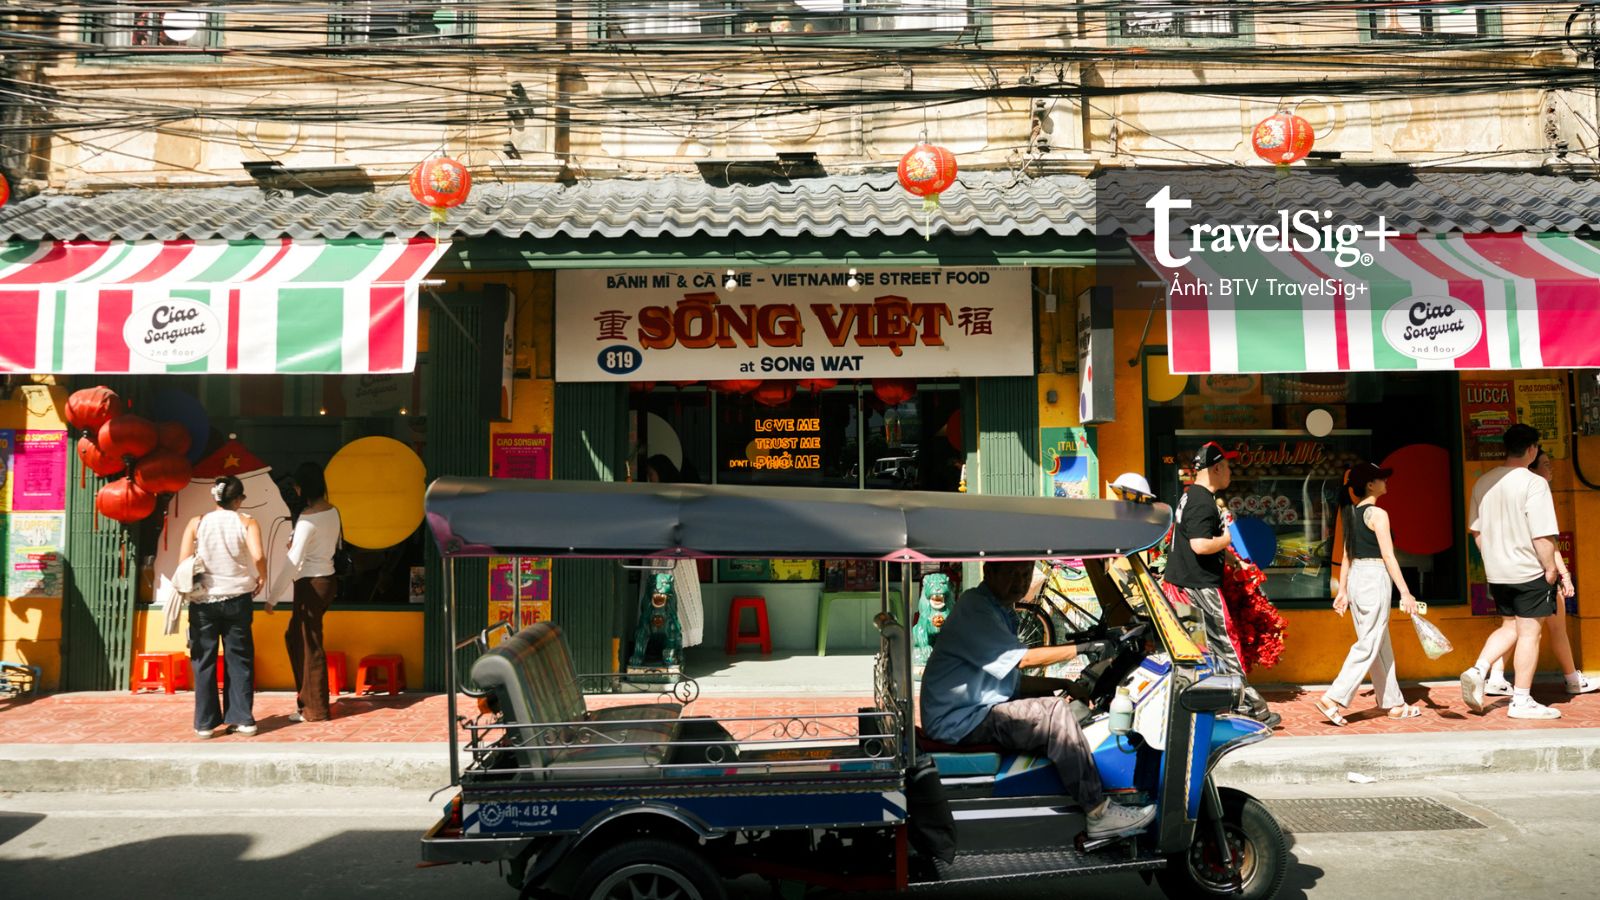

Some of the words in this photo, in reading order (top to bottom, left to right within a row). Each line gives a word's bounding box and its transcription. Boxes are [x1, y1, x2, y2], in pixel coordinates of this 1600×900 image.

[606, 272, 648, 289] BÁNH
[652, 272, 678, 288] MÌ
[677, 275, 687, 288] &
[693, 271, 716, 287] CÀ
[879, 271, 941, 285] STREET
[946, 271, 990, 285] FOOD
[152, 305, 199, 330] Ciao
[957, 306, 994, 337] 福
[1409, 301, 1456, 326] Ciao
[144, 322, 206, 344] Songwat
[594, 310, 632, 341] 重
[808, 295, 953, 357] VIỆT
[1404, 319, 1465, 341] Songwat
[150, 349, 168, 357] 2nd
[172, 348, 194, 357] floor
[1433, 345, 1455, 353] floor
[606, 351, 633, 369] 819
[740, 361, 755, 373] at
[761, 357, 814, 372] SONG
[820, 356, 863, 372] WAT
[1467, 387, 1510, 403] LUCCA
[755, 419, 794, 432] LOVE
[797, 418, 820, 431] ME
[755, 438, 798, 449] TRUST
[800, 437, 821, 449] ME
[1057, 441, 1081, 451] ITALY
[795, 455, 820, 468] ME
